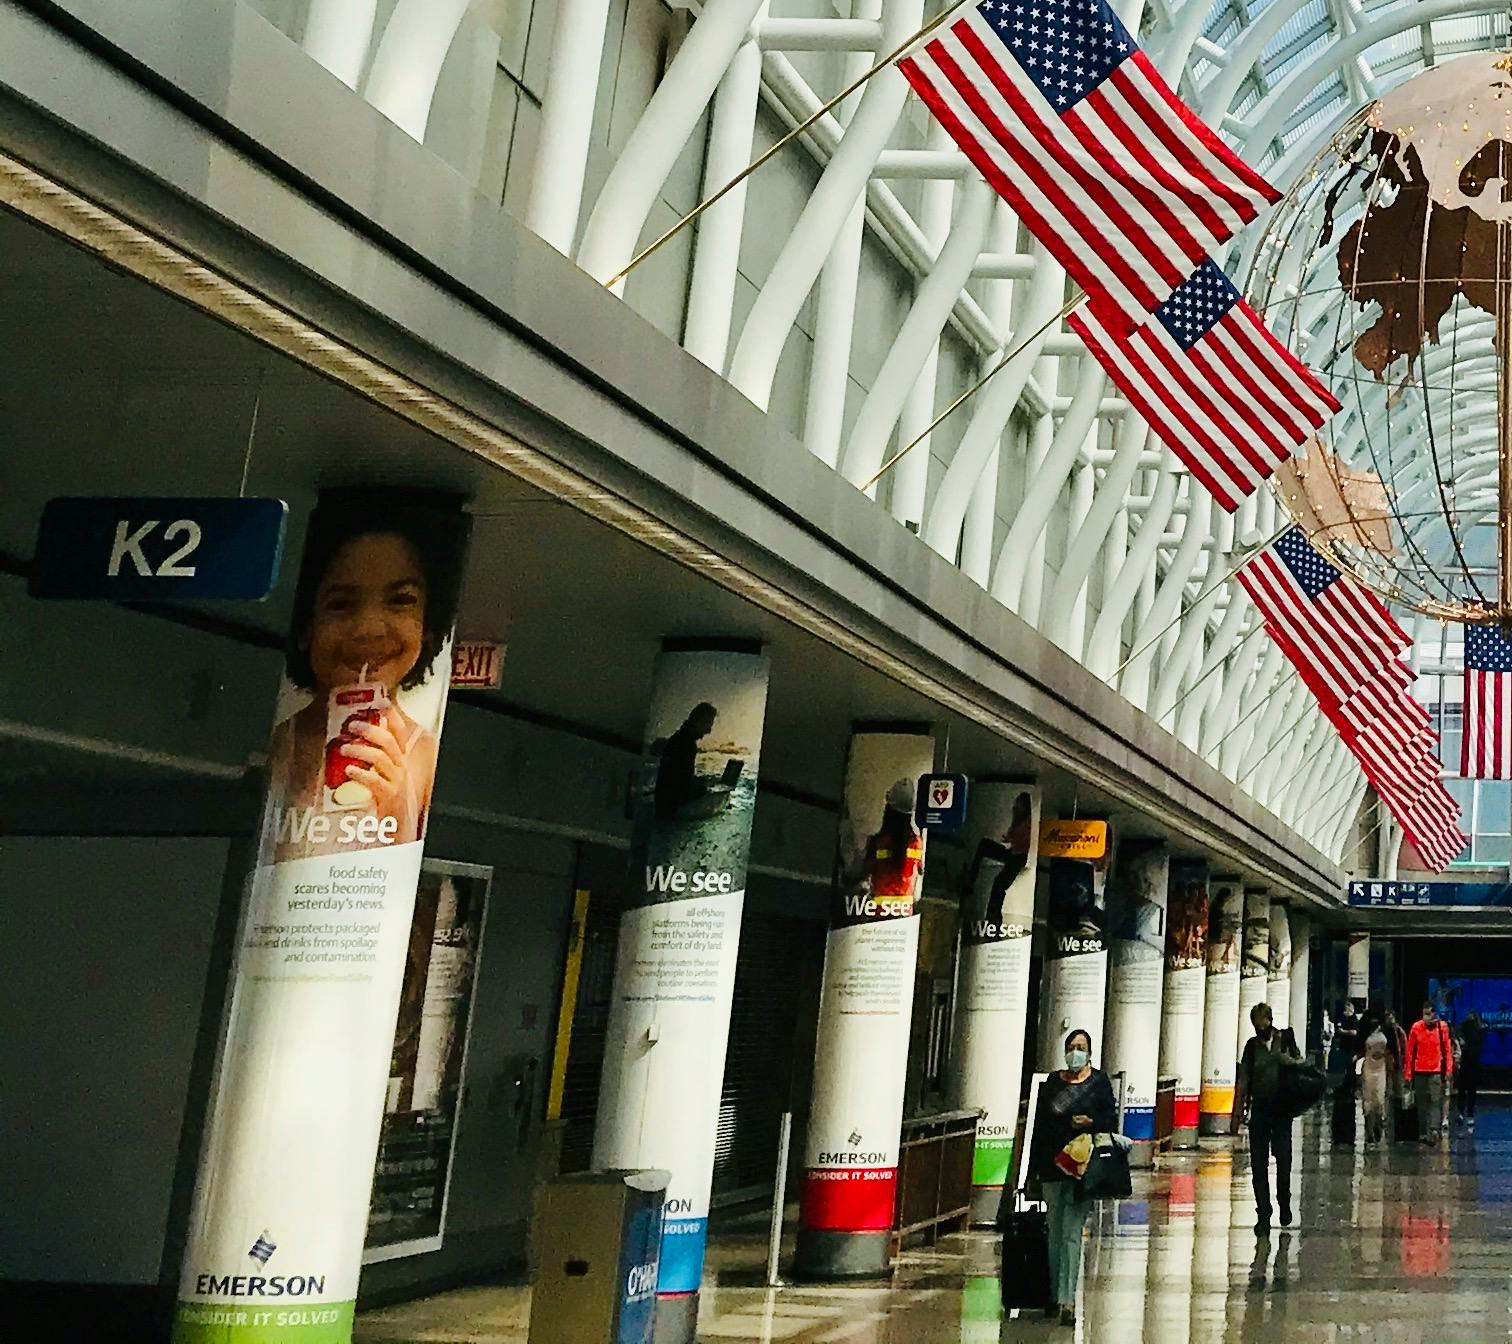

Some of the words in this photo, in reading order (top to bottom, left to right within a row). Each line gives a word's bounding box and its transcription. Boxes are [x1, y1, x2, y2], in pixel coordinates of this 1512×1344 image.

[107, 520, 202, 577] K2
[452, 646, 496, 677] EXIT
[274, 807, 331, 844] We
[336, 815, 398, 844] see
[329, 866, 356, 880] food
[357, 866, 389, 881] safety
[645, 865, 688, 892] We
[690, 871, 732, 892] see
[294, 883, 330, 894] scares
[331, 882, 387, 897] becoming
[287, 898, 353, 911] yesterday's
[845, 895, 877, 916] We
[879, 900, 911, 917] see
[290, 923, 334, 936] protects
[335, 922, 381, 936] packaged
[971, 920, 997, 937] We
[998, 924, 1025, 938] see
[313, 938, 339, 948] from
[1058, 936, 1080, 951] We
[1081, 939, 1103, 952] see
[284, 952, 304, 963] and
[818, 1152, 888, 1164] EMERSON
[851, 1171, 861, 1180] IT
[195, 1274, 326, 1297] EMERSON
[252, 1312, 273, 1326] IT
[275, 1310, 340, 1327] SOLVED
